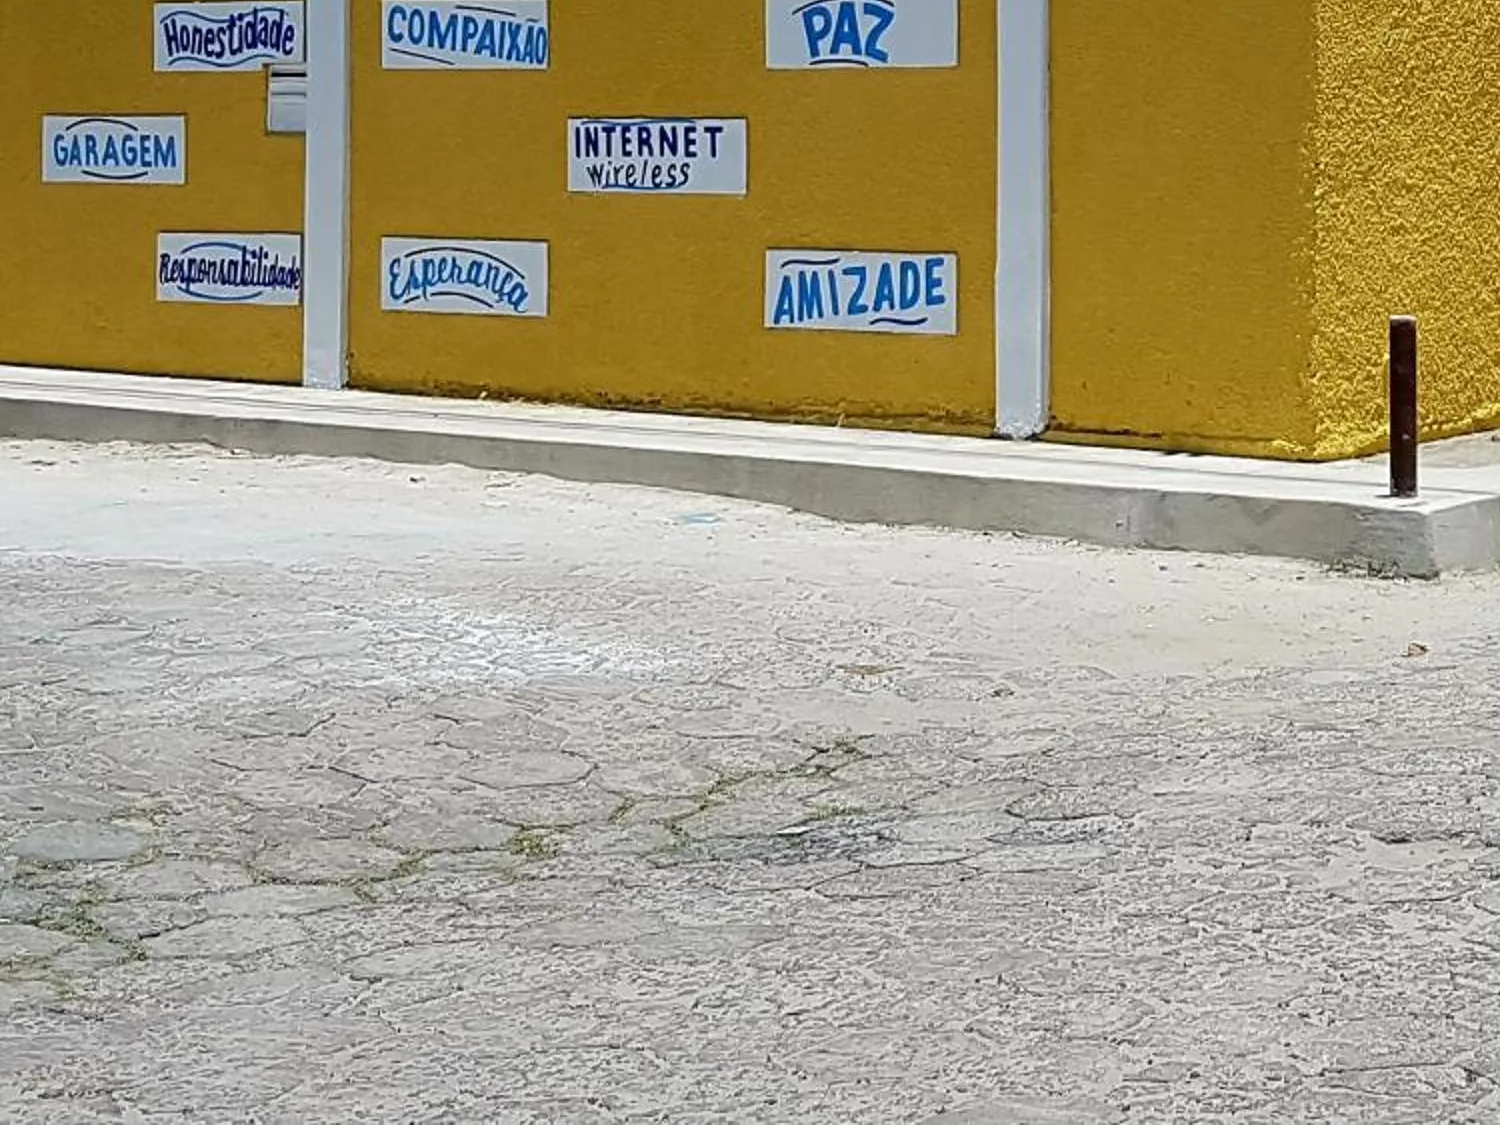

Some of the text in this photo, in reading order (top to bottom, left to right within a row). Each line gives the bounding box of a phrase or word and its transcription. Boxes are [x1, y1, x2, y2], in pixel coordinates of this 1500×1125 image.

[164, 6, 295, 58] Honestidade
[387, 4, 548, 65] COMPAIXÃO
[801, 1, 895, 63] PAZ
[53, 133, 177, 169] GARAGEM
[575, 125, 724, 158] INTERNET
[586, 161, 691, 188] wireless
[159, 245, 301, 292] Responsabilidade
[390, 255, 530, 313] Esperança
[773, 256, 946, 325] AMIZADE
